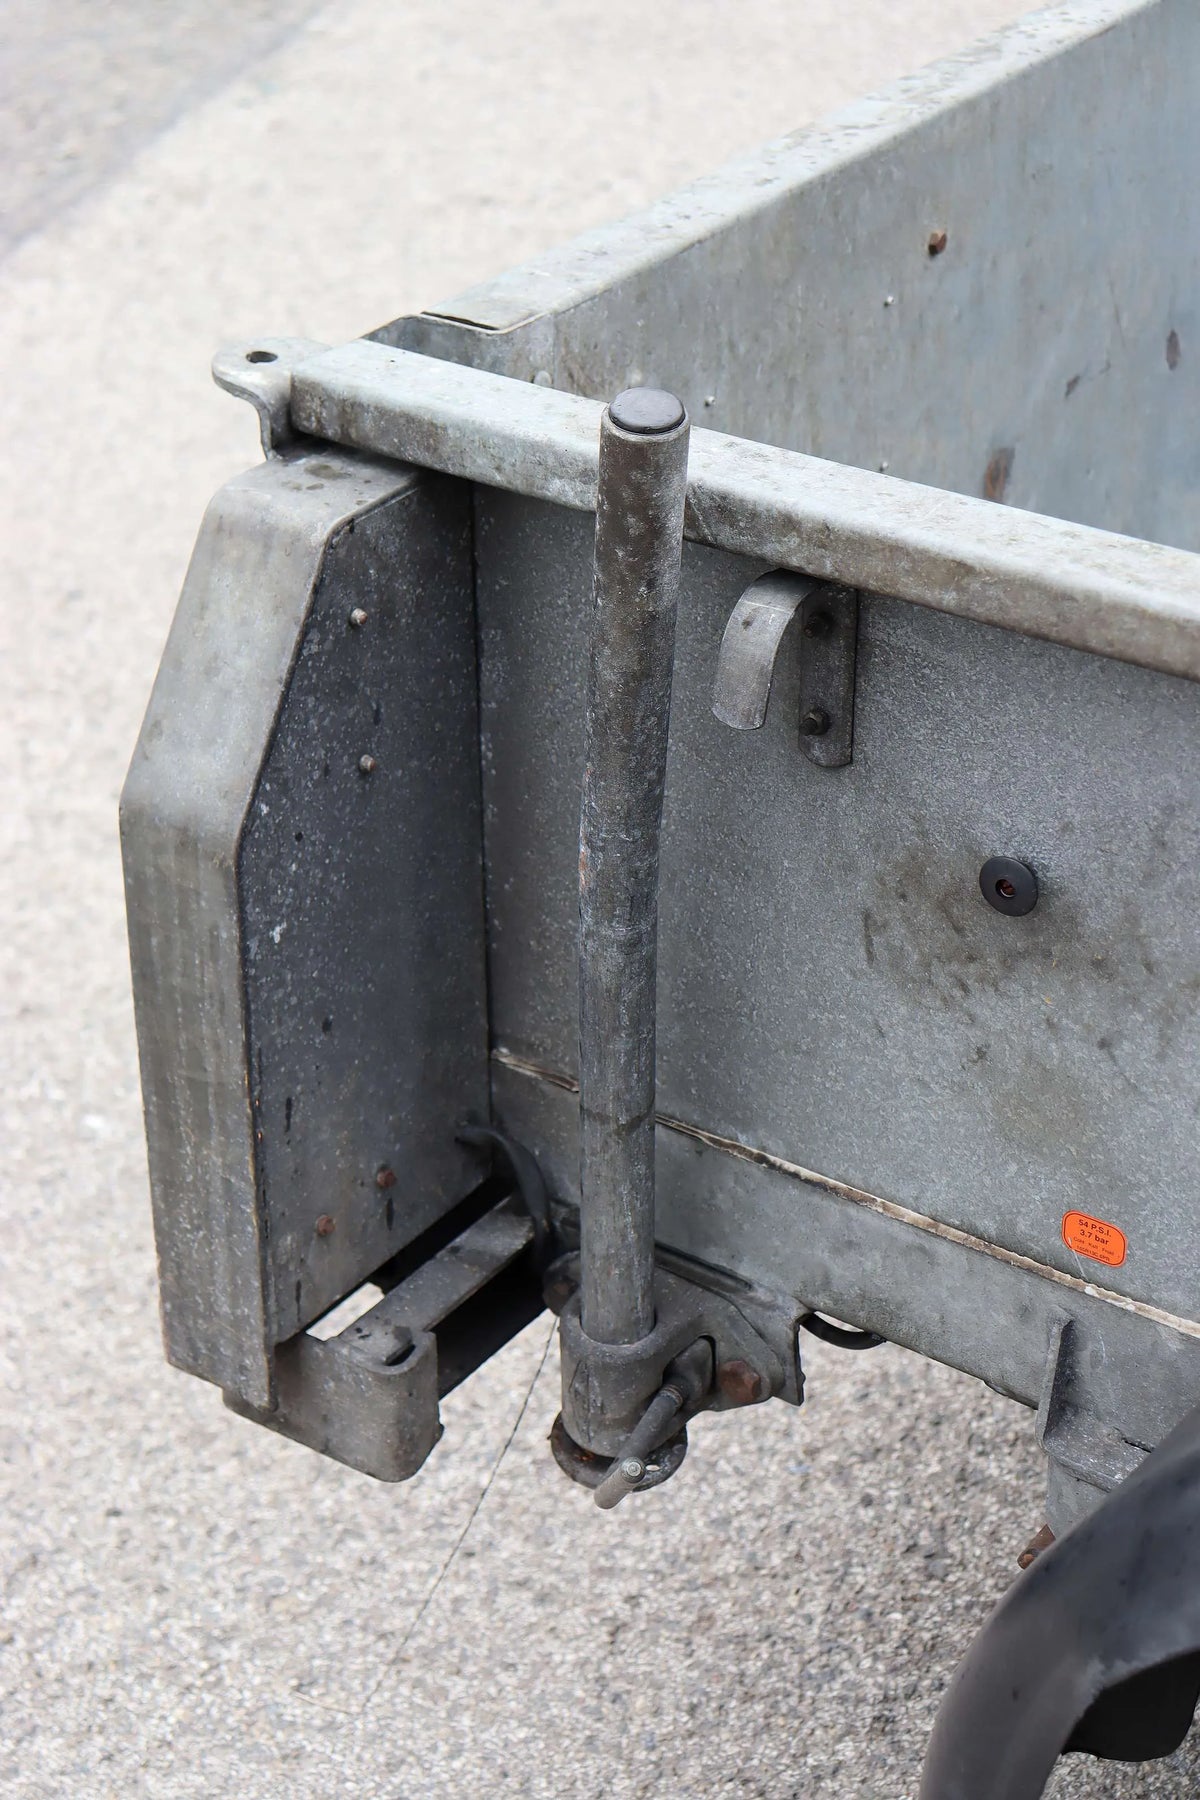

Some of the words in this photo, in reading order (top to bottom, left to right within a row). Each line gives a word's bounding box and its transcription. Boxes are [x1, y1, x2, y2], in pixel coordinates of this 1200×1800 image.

[1078, 1219, 1088, 1227] 54
[1091, 1223, 1111, 1237] P.S.I.
[1079, 1229, 1092, 1238] 3.7
[1095, 1235, 1109, 1245] bar
